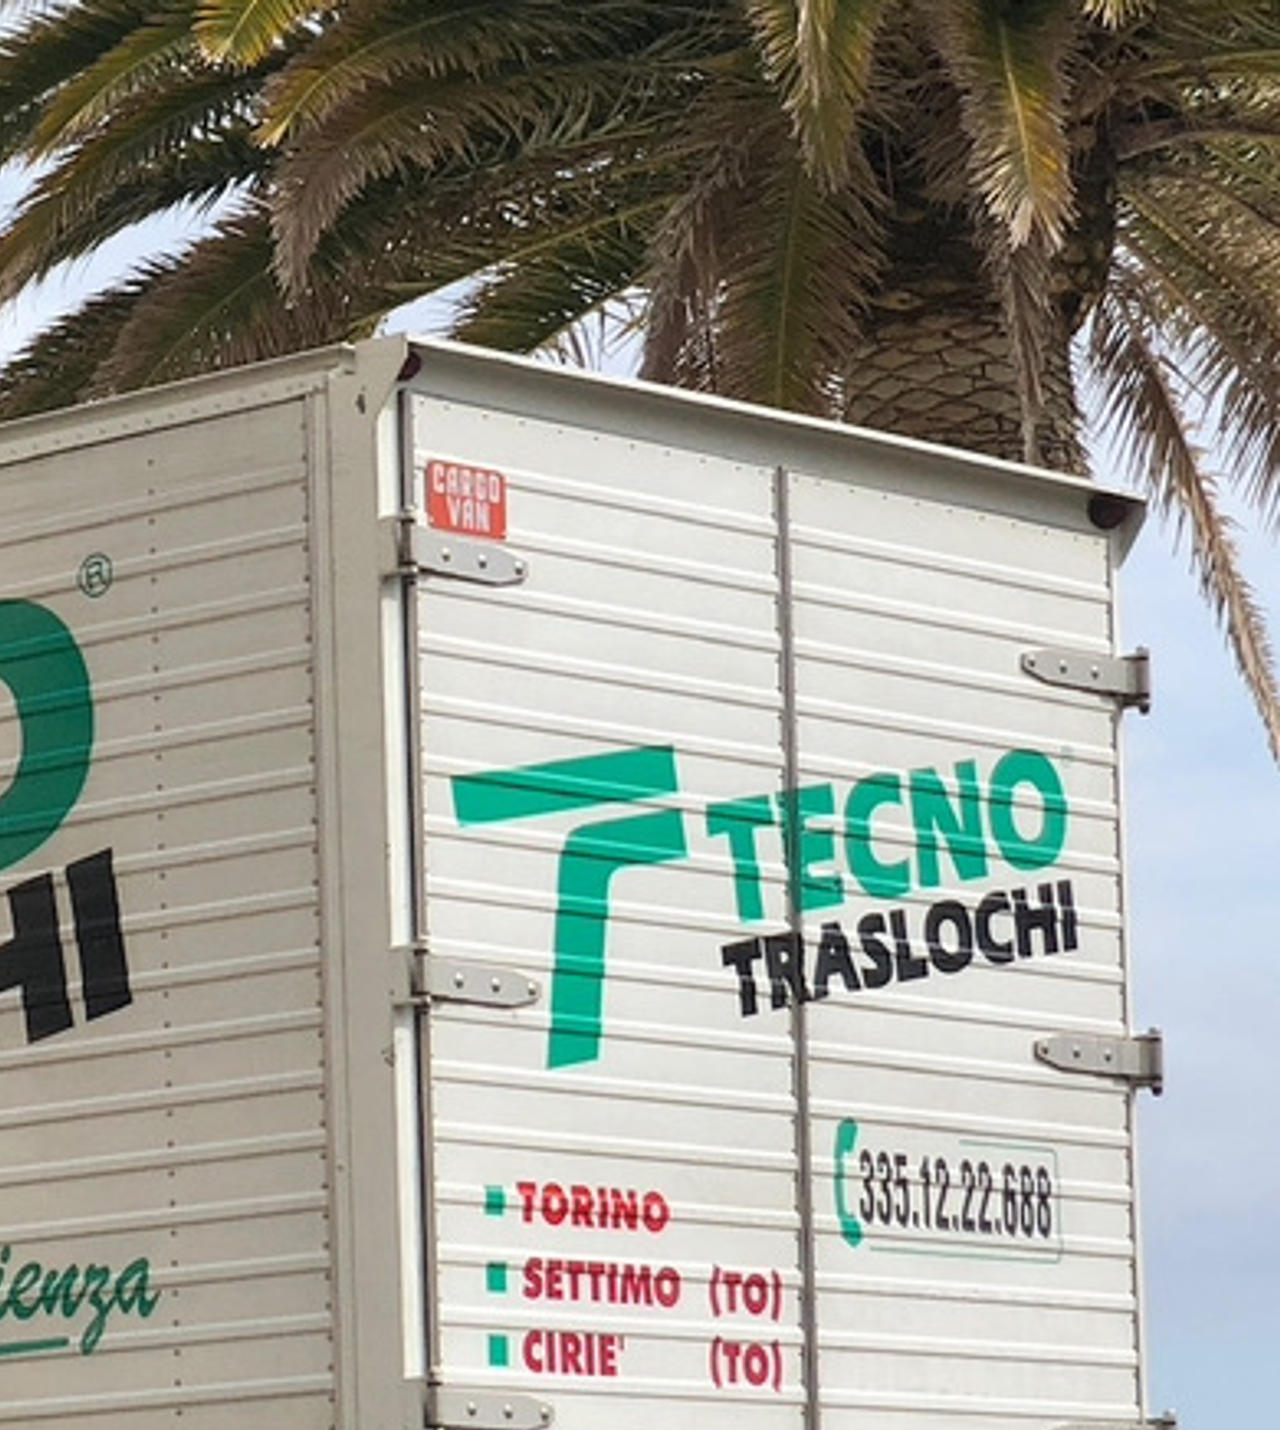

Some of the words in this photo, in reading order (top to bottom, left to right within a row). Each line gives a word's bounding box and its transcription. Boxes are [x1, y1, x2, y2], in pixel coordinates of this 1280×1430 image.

[432, 463, 501, 504] CARGO
[445, 494, 491, 533] VAN
[706, 748, 1068, 924] TECNO
[721, 880, 1079, 1018] TRASLOCHI
[515, 1182, 671, 1233] TORINO
[858, 1150, 1053, 1239] 335.12.22.688
[522, 1258, 681, 1308] SETTIMO
[708, 1266, 783, 1321] (TO)
[708, 1336, 783, 1391] (TO)
